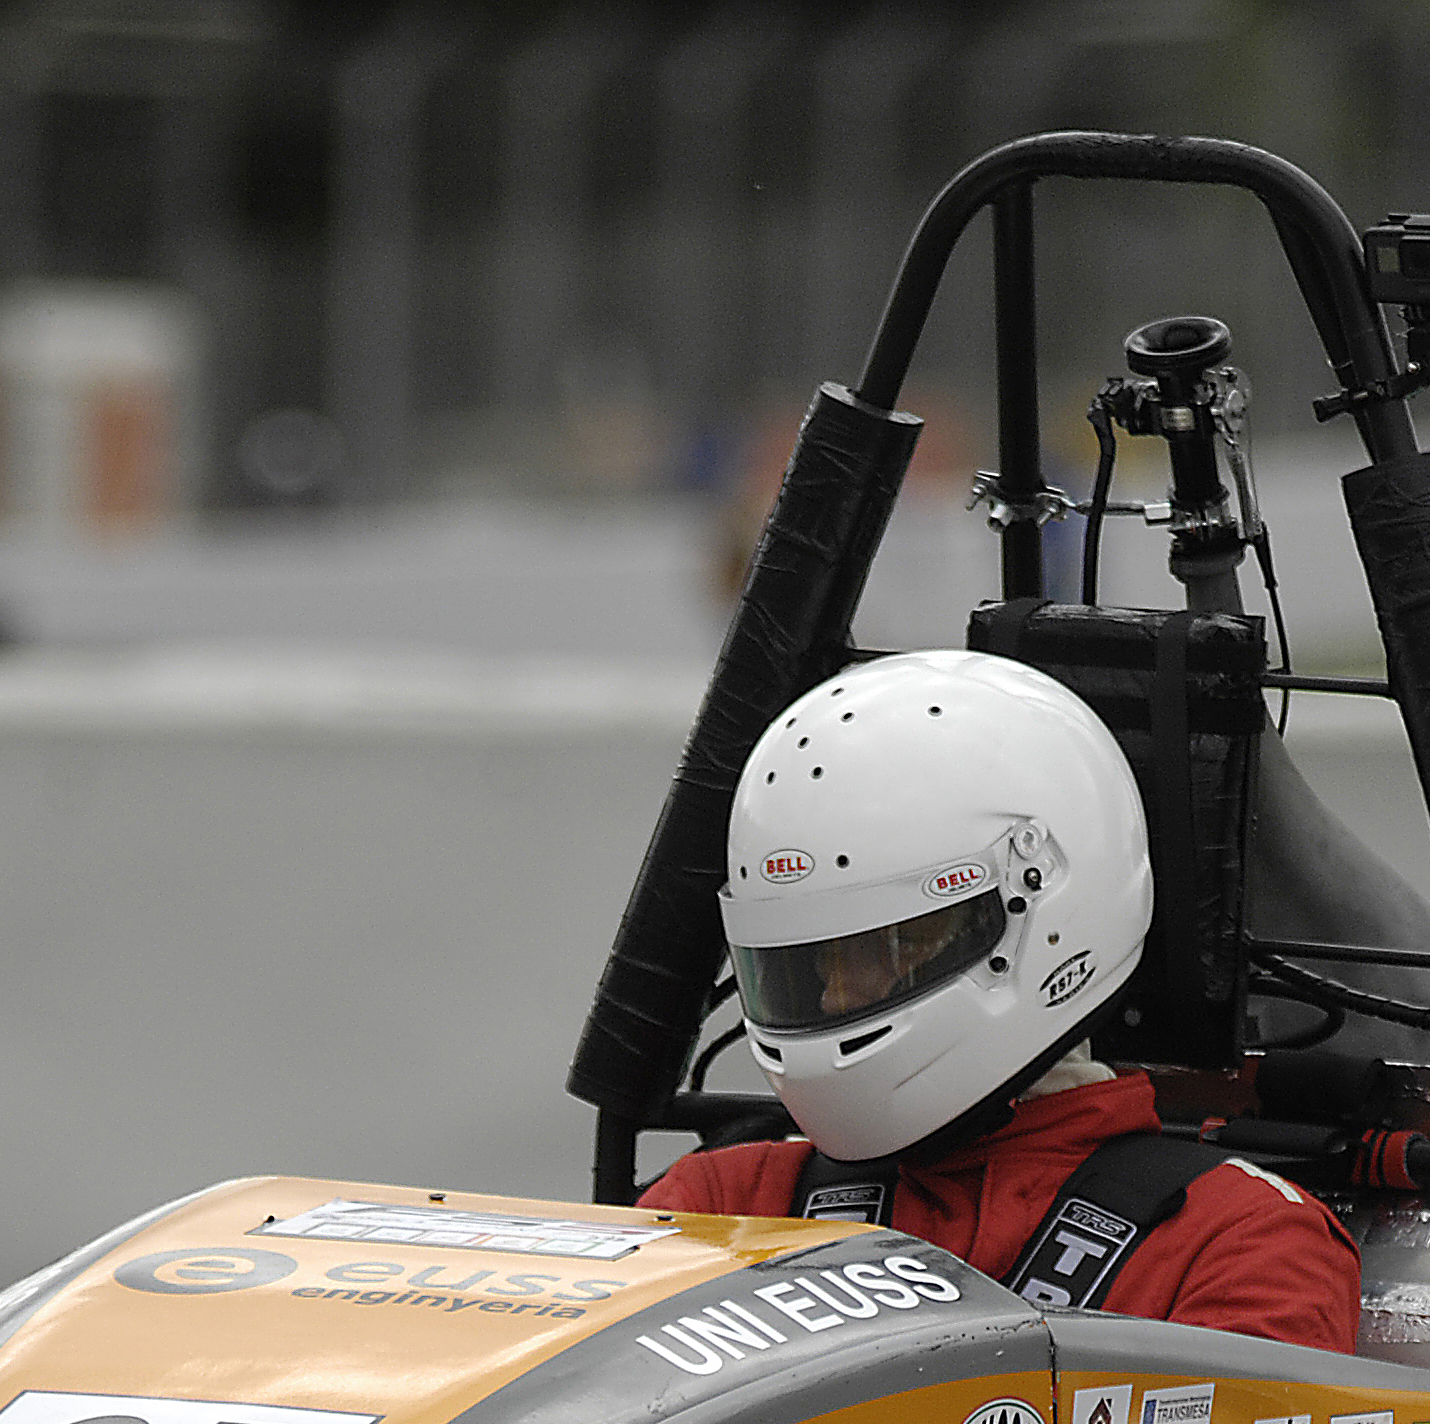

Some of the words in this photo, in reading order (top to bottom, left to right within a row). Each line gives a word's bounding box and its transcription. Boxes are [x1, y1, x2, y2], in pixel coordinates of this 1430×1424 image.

[766, 857, 807, 874] BELL
[937, 868, 979, 890] BELL
[1071, 1205, 1126, 1236] TRS
[325, 1261, 629, 1301] euss
[291, 1283, 588, 1320] enginyeria
[635, 1300, 788, 1375] UNI
[754, 1256, 961, 1333] EUSS
